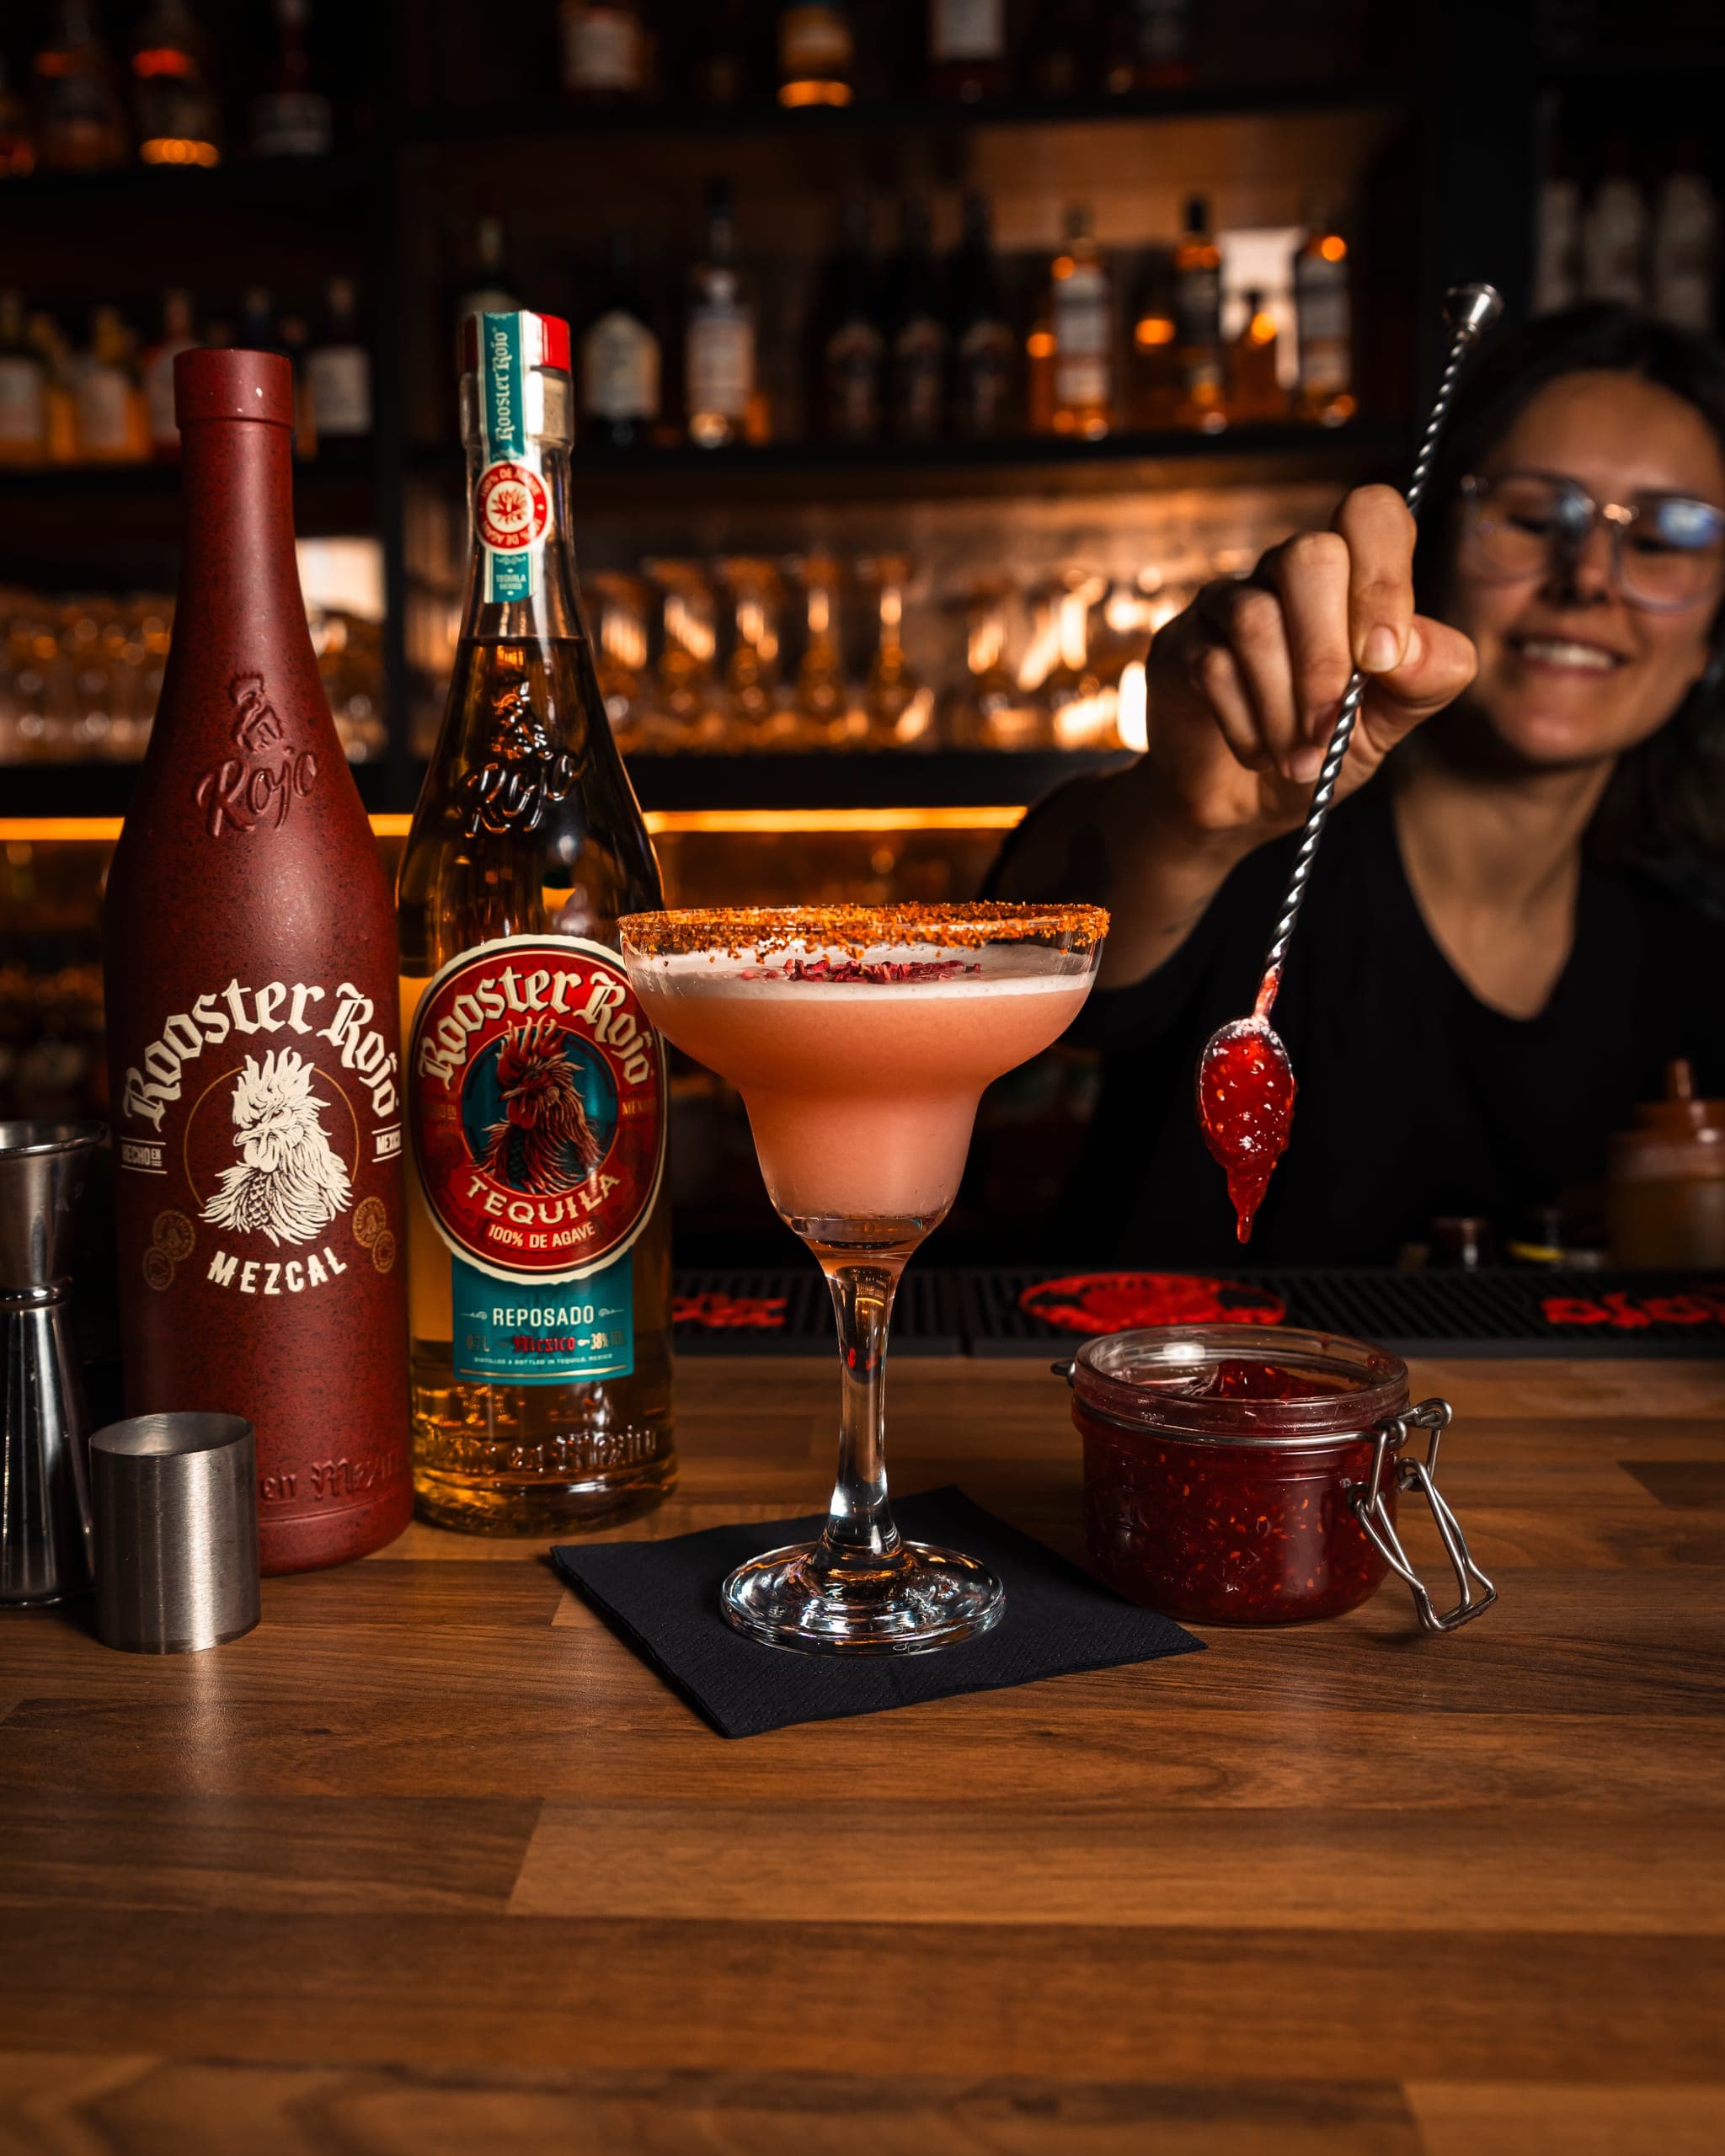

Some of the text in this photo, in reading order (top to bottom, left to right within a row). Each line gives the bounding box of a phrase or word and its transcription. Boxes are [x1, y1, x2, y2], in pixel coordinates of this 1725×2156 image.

[490, 332, 515, 442] Rooster Rojo
[418, 966, 654, 1091] Rooster Rojo
[122, 978, 398, 1133] Rooster Rojo
[466, 1173, 621, 1226] TEQUILA
[488, 1221, 595, 1249] 100% DE AGAVE
[206, 1246, 348, 1295] MEZCAL
[492, 1305, 595, 1327] REPOSADO
[512, 1335, 576, 1353] Mexico
